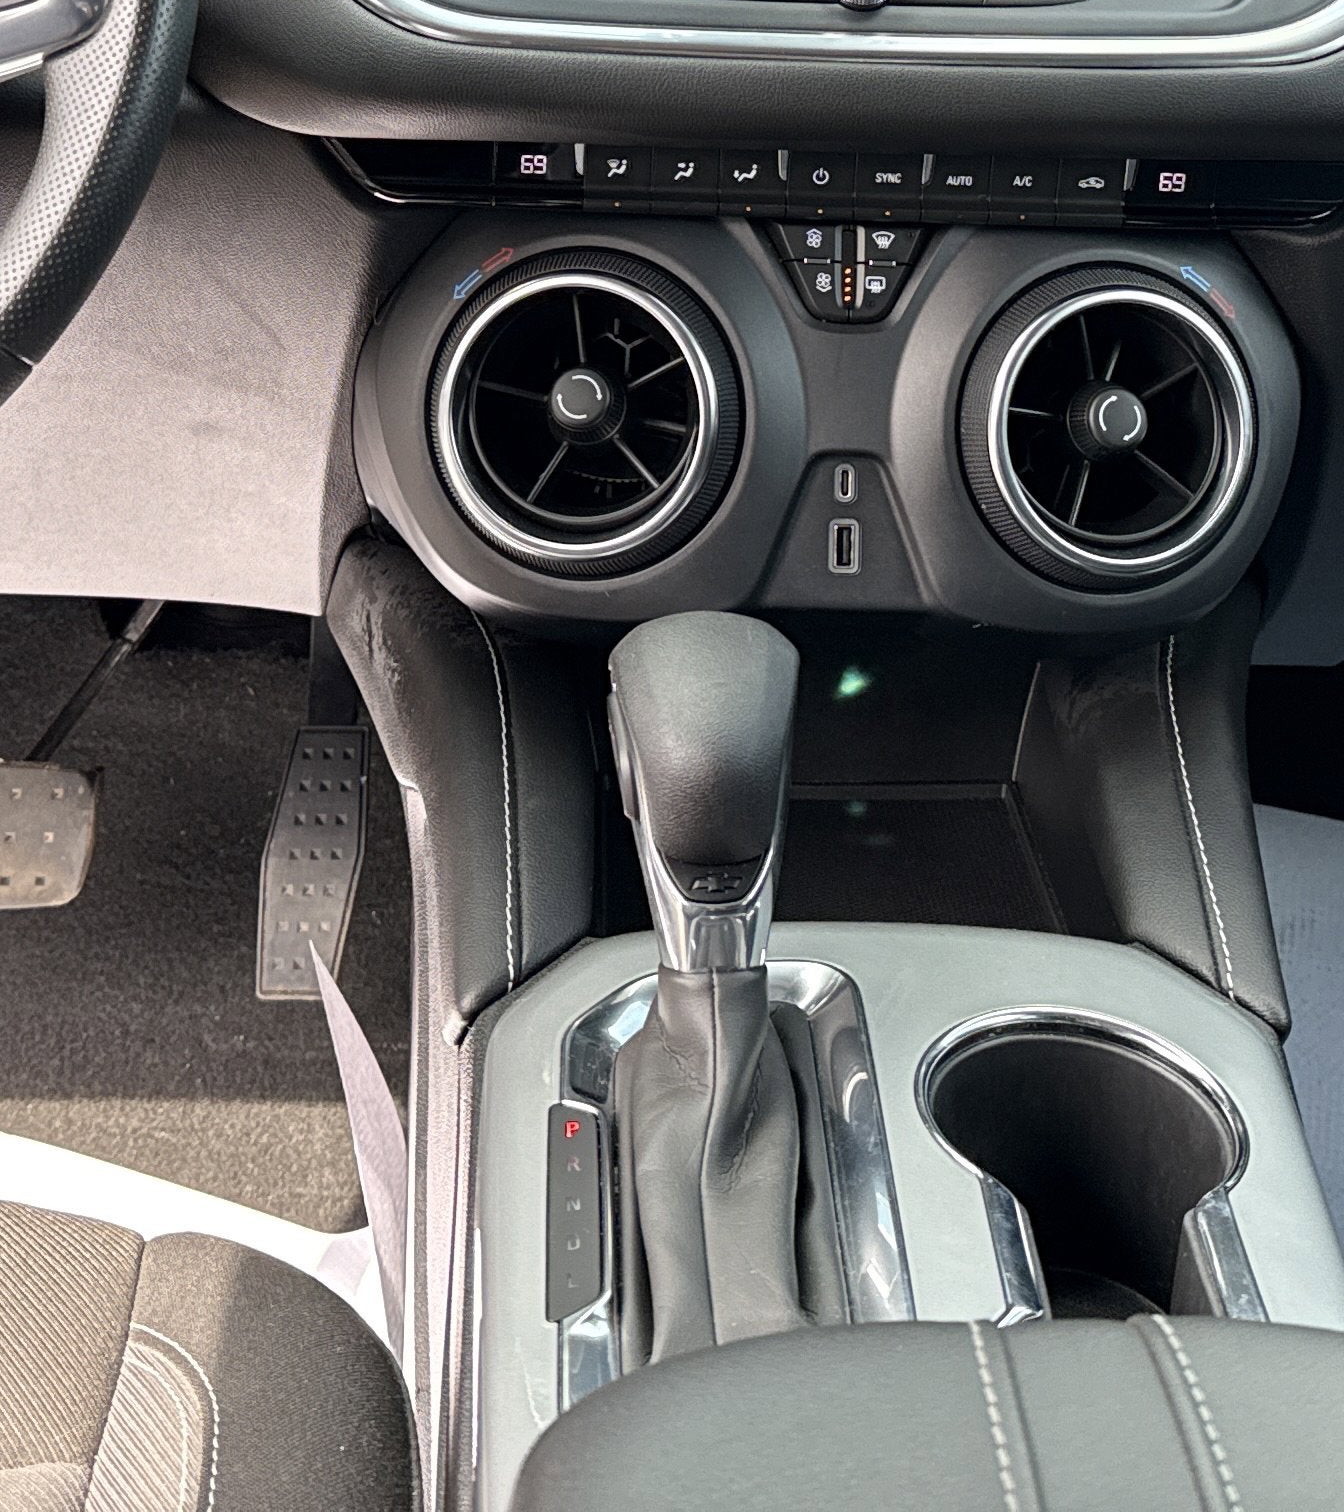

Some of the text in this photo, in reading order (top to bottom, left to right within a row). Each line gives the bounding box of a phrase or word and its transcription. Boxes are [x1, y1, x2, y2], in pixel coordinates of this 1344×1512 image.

[520, 154, 548, 175] 69
[875, 172, 903, 185] SYNC
[946, 175, 974, 187] AUTO
[1012, 175, 1034, 188] A/C
[1159, 172, 1187, 193] 69
[565, 1120, 580, 1138] P
[567, 1156, 582, 1172] R
[566, 1196, 582, 1212] N
